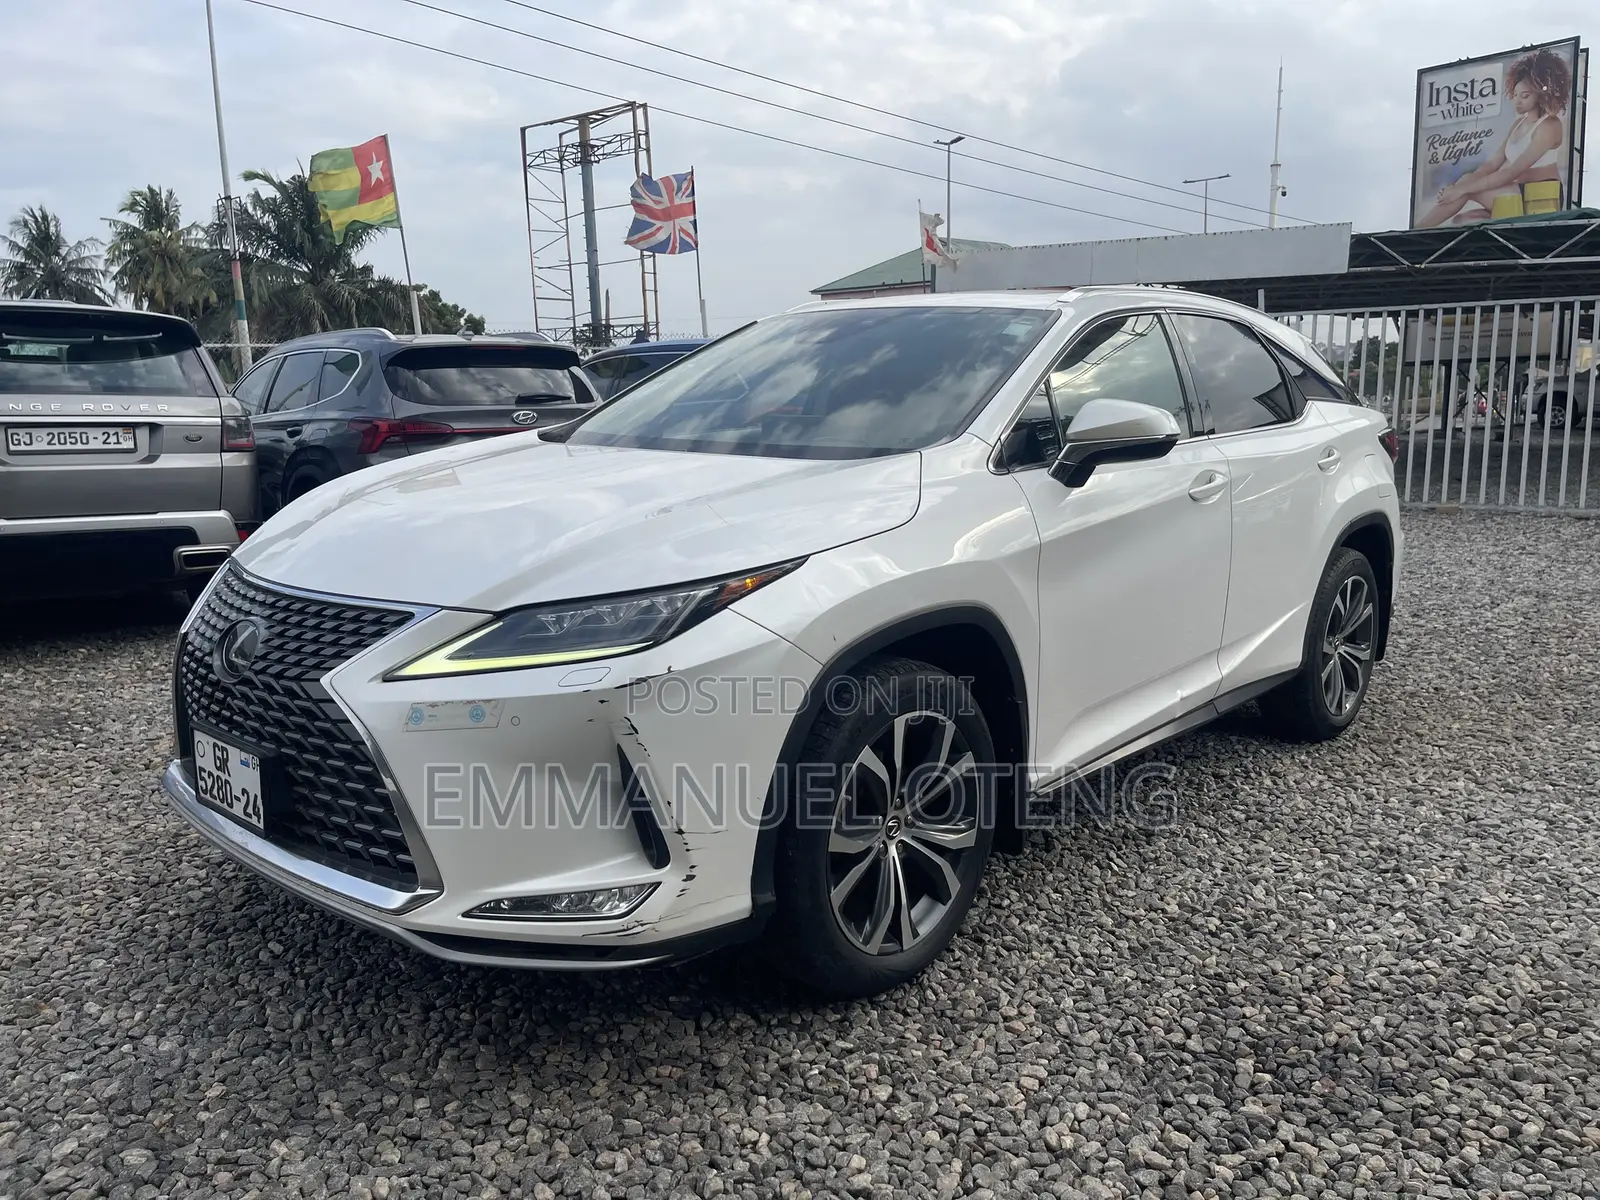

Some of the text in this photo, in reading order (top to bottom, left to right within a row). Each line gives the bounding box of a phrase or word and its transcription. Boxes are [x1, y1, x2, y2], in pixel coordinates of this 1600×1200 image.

[1427, 76, 1497, 108] Insta
[1441, 102, 1484, 120] white
[1426, 128, 1494, 151] Radiance
[1428, 139, 1484, 165] & light
[0, 403, 169, 412] NGE ROVER
[10, 431, 122, 446] GJ 2050-21
[212, 742, 231, 777] GR
[198, 766, 261, 823] 5280-24
